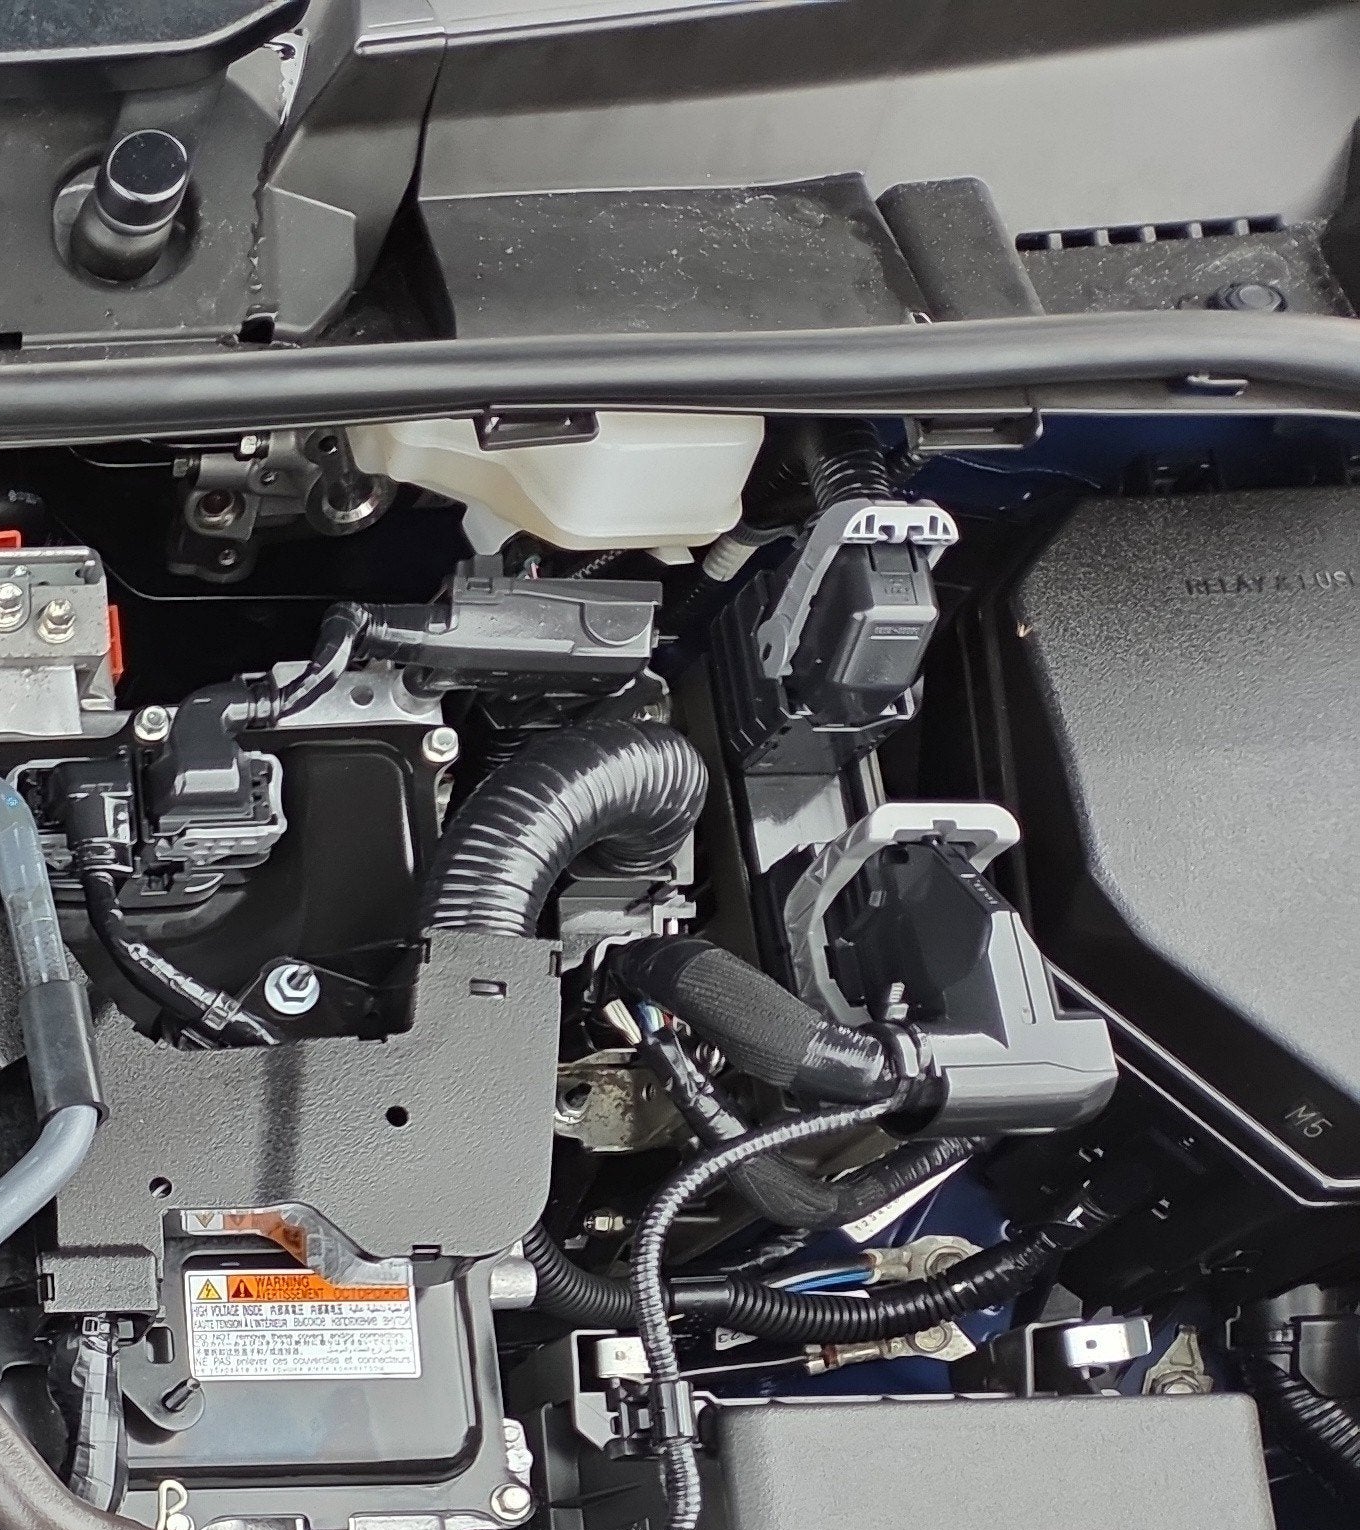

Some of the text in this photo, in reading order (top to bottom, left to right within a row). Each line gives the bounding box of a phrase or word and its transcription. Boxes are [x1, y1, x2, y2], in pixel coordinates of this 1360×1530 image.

[1184, 574, 1265, 597] RELAY
[1284, 1105, 1333, 1138] M5
[255, 1275, 310, 1288] WARNING
[211, 1304, 239, 1316] VOLTAGE
